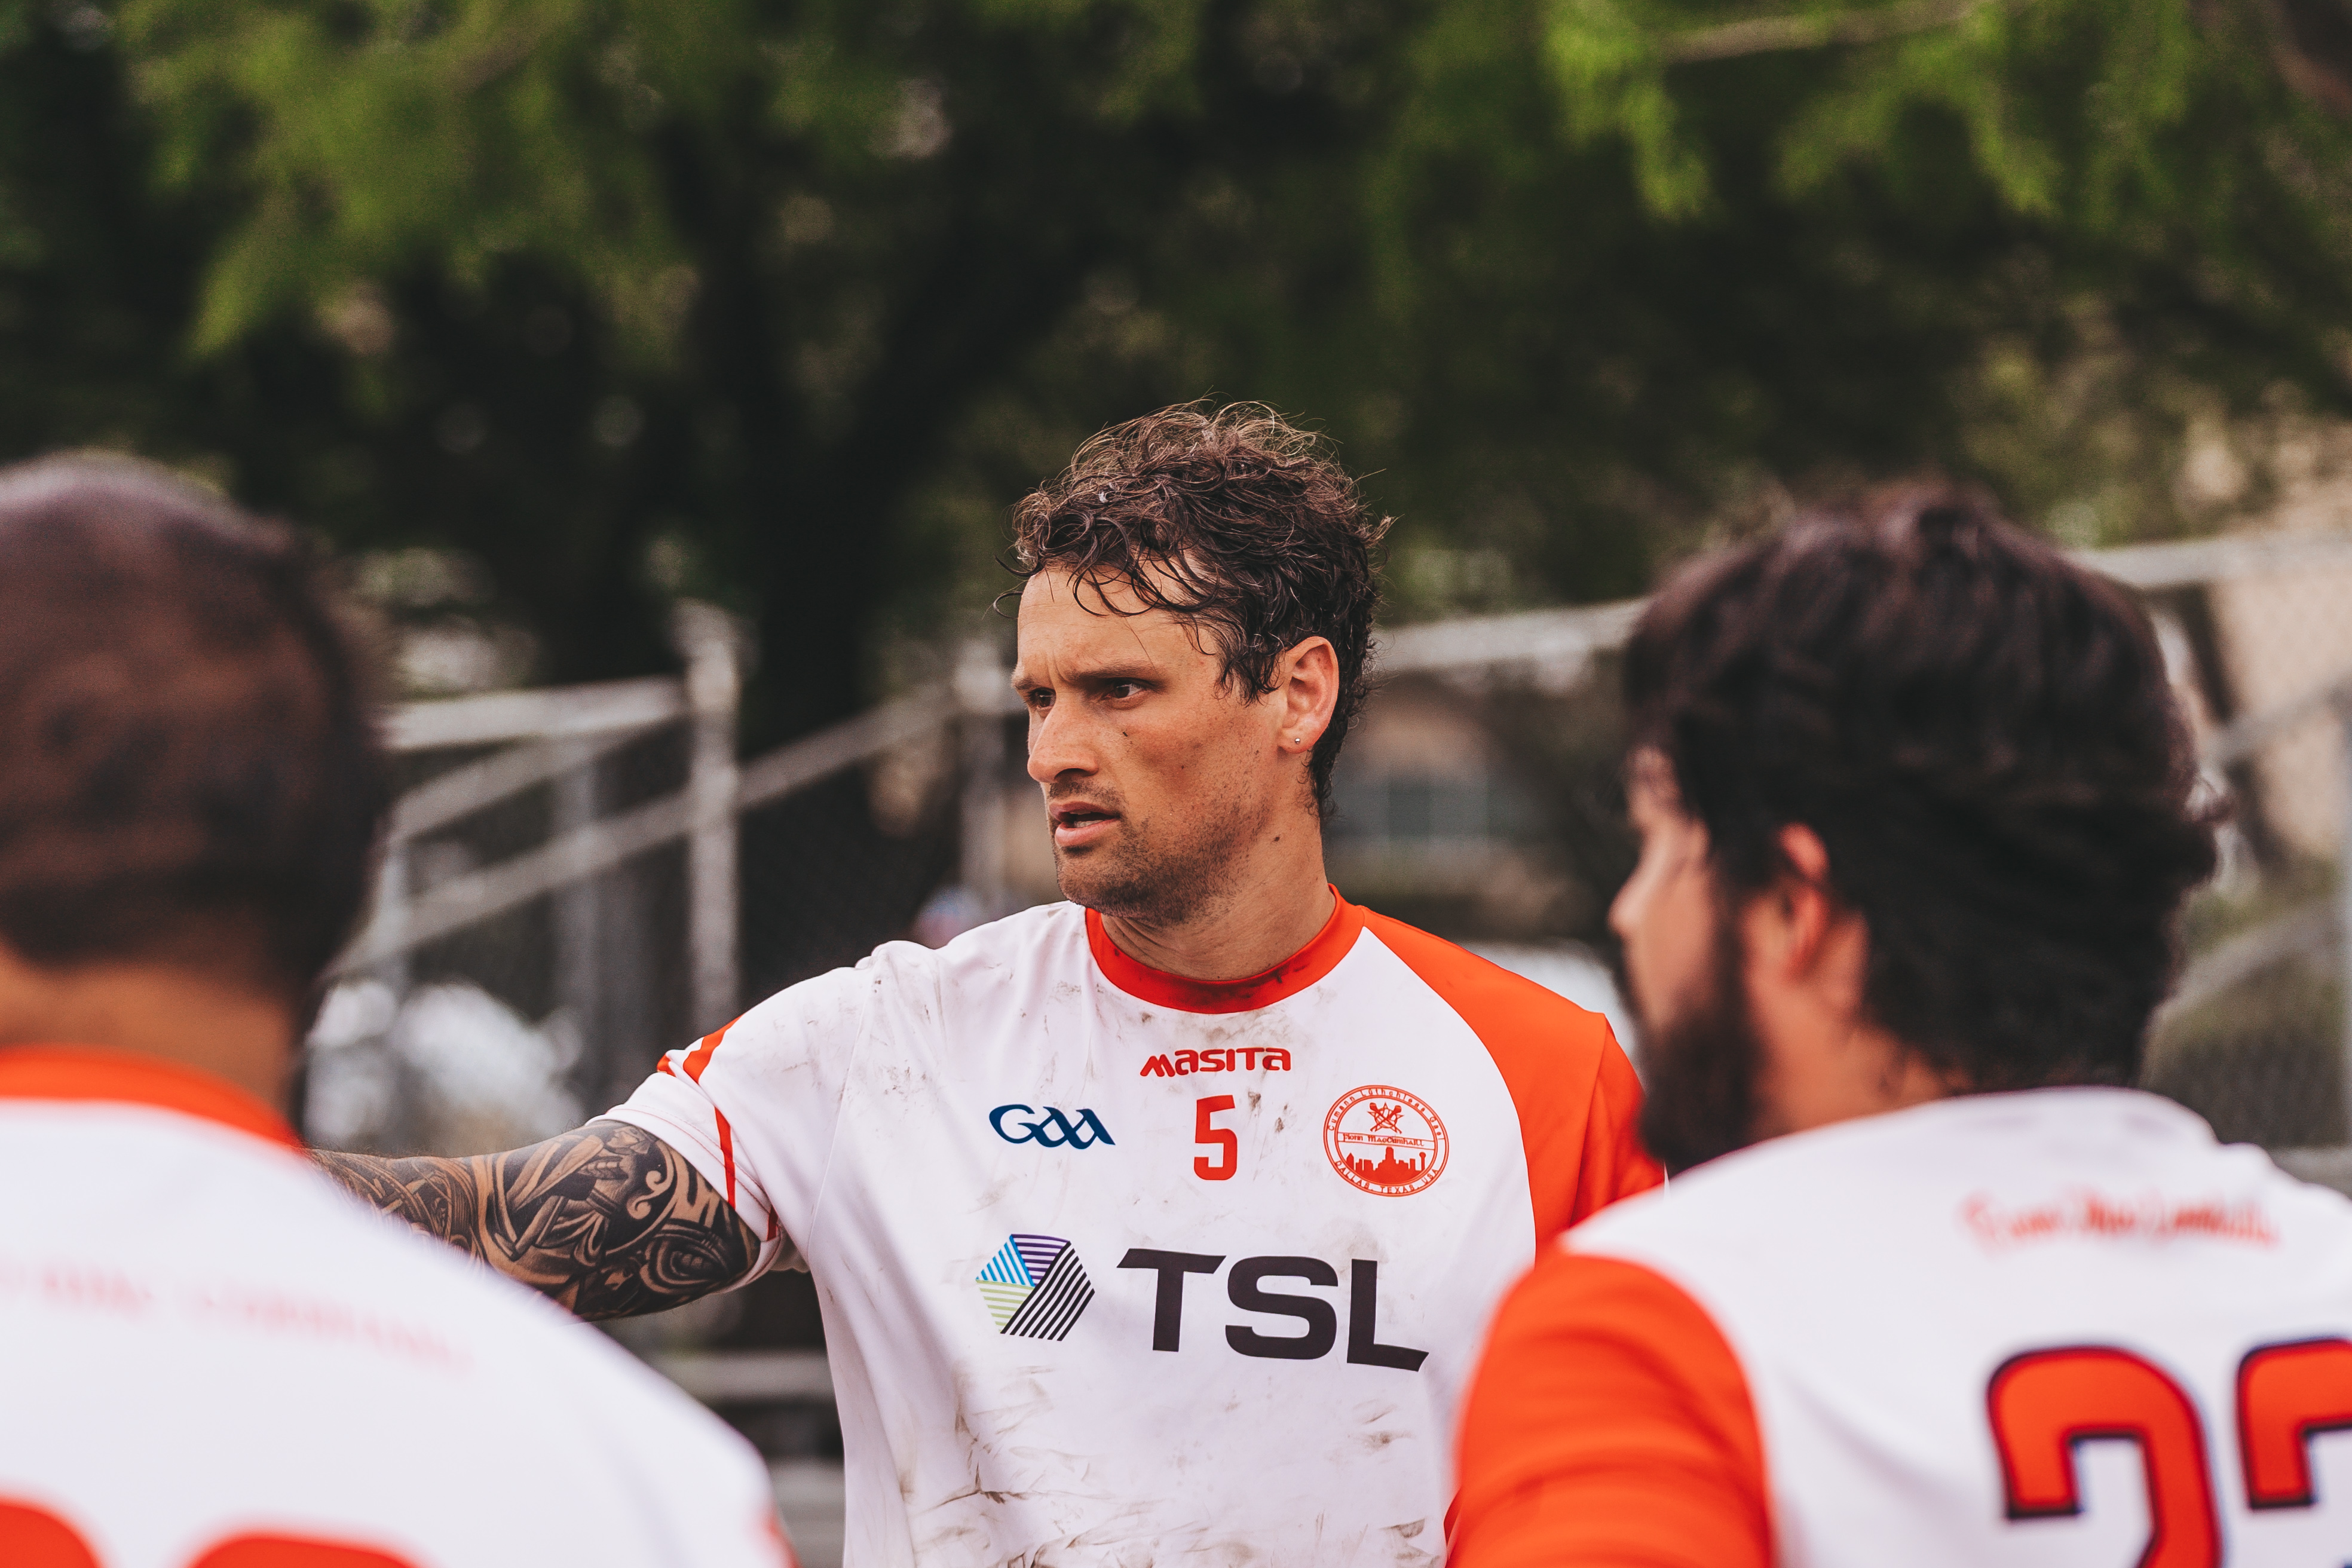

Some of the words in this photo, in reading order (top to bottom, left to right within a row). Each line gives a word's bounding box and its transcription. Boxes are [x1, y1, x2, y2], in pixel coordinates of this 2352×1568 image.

[1193, 1094, 1238, 1181] 5
[1327, 1096, 1356, 1131] Cumann
[1421, 1168, 1439, 1185] USA
[1116, 1248, 1430, 1373] TSL
